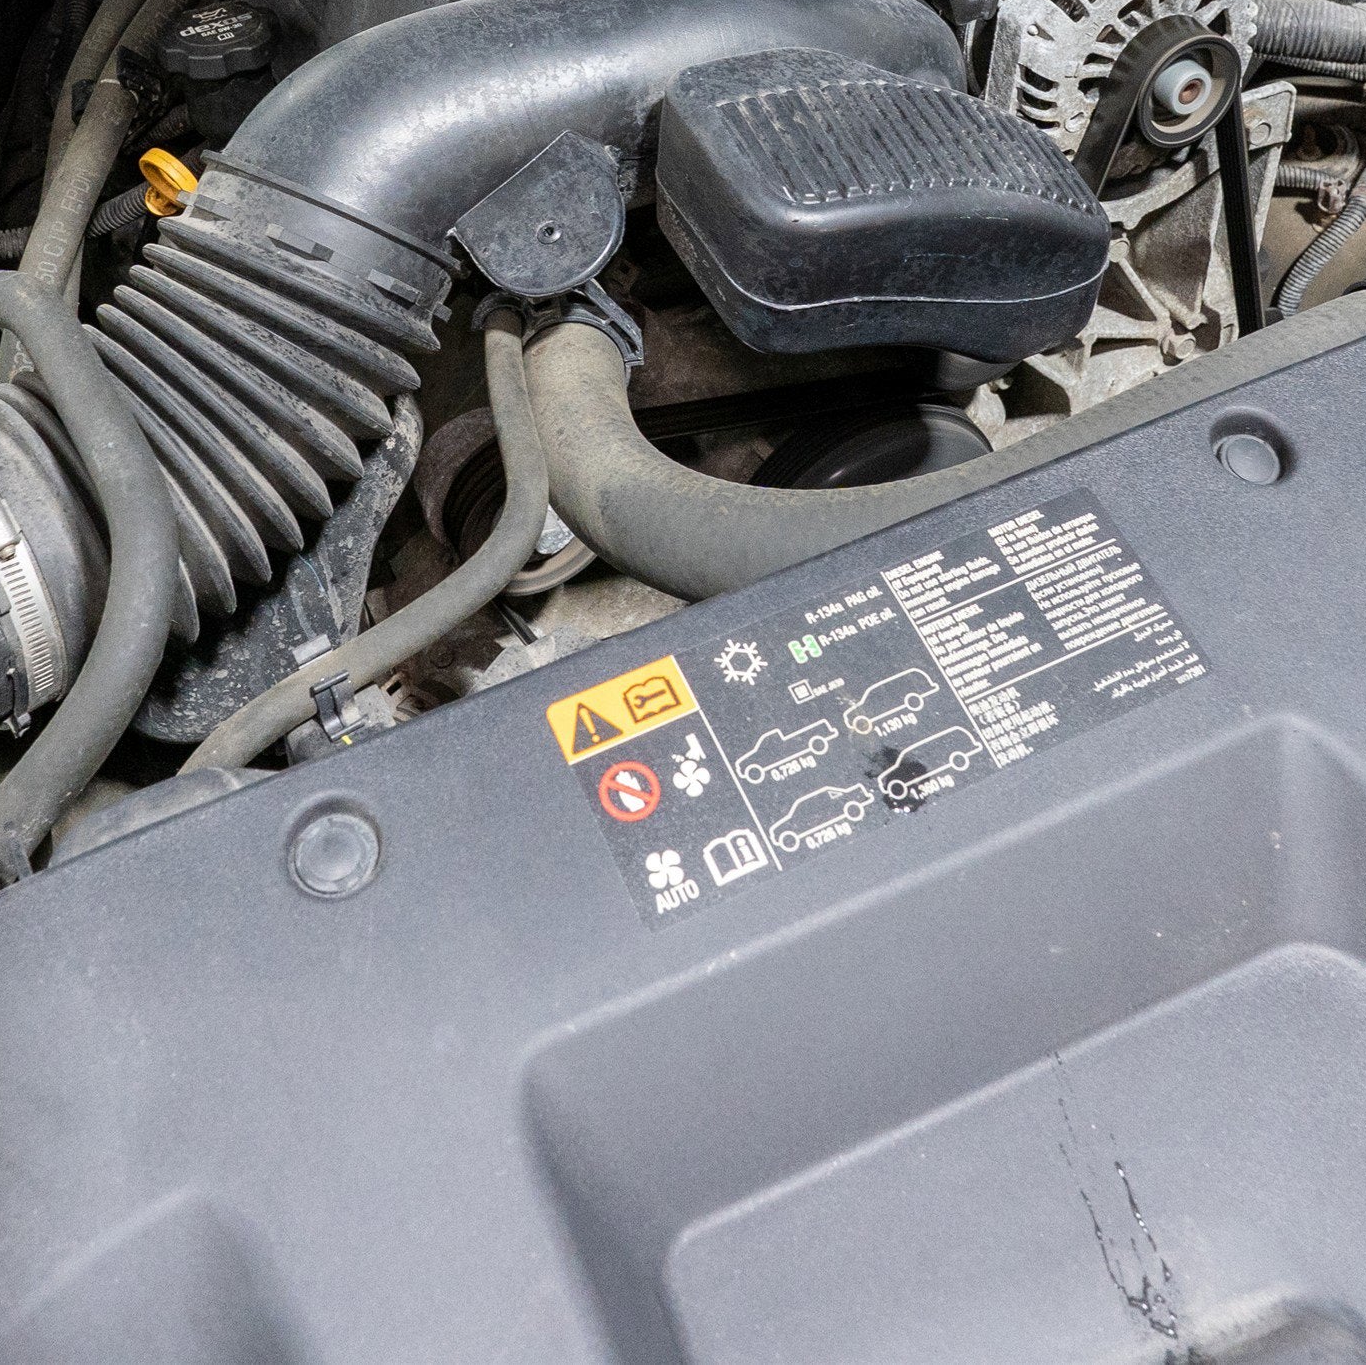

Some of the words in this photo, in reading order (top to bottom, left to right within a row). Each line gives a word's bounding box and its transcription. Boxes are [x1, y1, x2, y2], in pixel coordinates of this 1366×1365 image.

[178, 10, 252, 37] dexos
[200, 28, 217, 37] SAE
[987, 520, 1018, 537] MOTOR
[1015, 510, 1044, 526] DIESEL
[1000, 546, 1014, 556] No
[1050, 525, 1063, 535] de
[1052, 548, 1066, 558] en
[885, 563, 915, 580] DIESEL
[912, 550, 944, 569] ENGINE
[897, 589, 911, 600] Do
[909, 583, 925, 595] not
[922, 577, 939, 589] use
[937, 566, 969, 582] starting
[965, 557, 992, 570] fluids.
[943, 574, 971, 592] engine
[968, 564, 1001, 581] damage
[1025, 563, 1077, 592] ДИЗЕЛЬНЫЙ
[1075, 546, 1122, 571] ДВИГАТЕЛЬ
[1037, 600, 1052, 610] Не
[1050, 579, 1102, 605] используйте
[1084, 591, 1101, 605] для
[1099, 574, 1143, 596] холодного
[1098, 593, 1126, 609] может
[805, 603, 844, 624] R-134a
[844, 591, 868, 607] PAG
[866, 585, 883, 599] oil.
[909, 607, 926, 619] can
[924, 597, 951, 613] result.
[818, 625, 858, 646] R-134a
[857, 612, 881, 630] POE
[879, 607, 897, 621] oil.
[919, 615, 955, 636] MOTEUR
[952, 604, 983, 622] DIESEL
[986, 622, 999, 633] de
[874, 717, 903, 737] 1,130
[900, 709, 918, 726] kg
[770, 761, 798, 781] 0,726
[795, 755, 817, 771] kg
[936, 774, 955, 788] kg
[805, 827, 835, 850] 0,726
[831, 820, 853, 839] kg
[654, 878, 700, 914] AUTO
